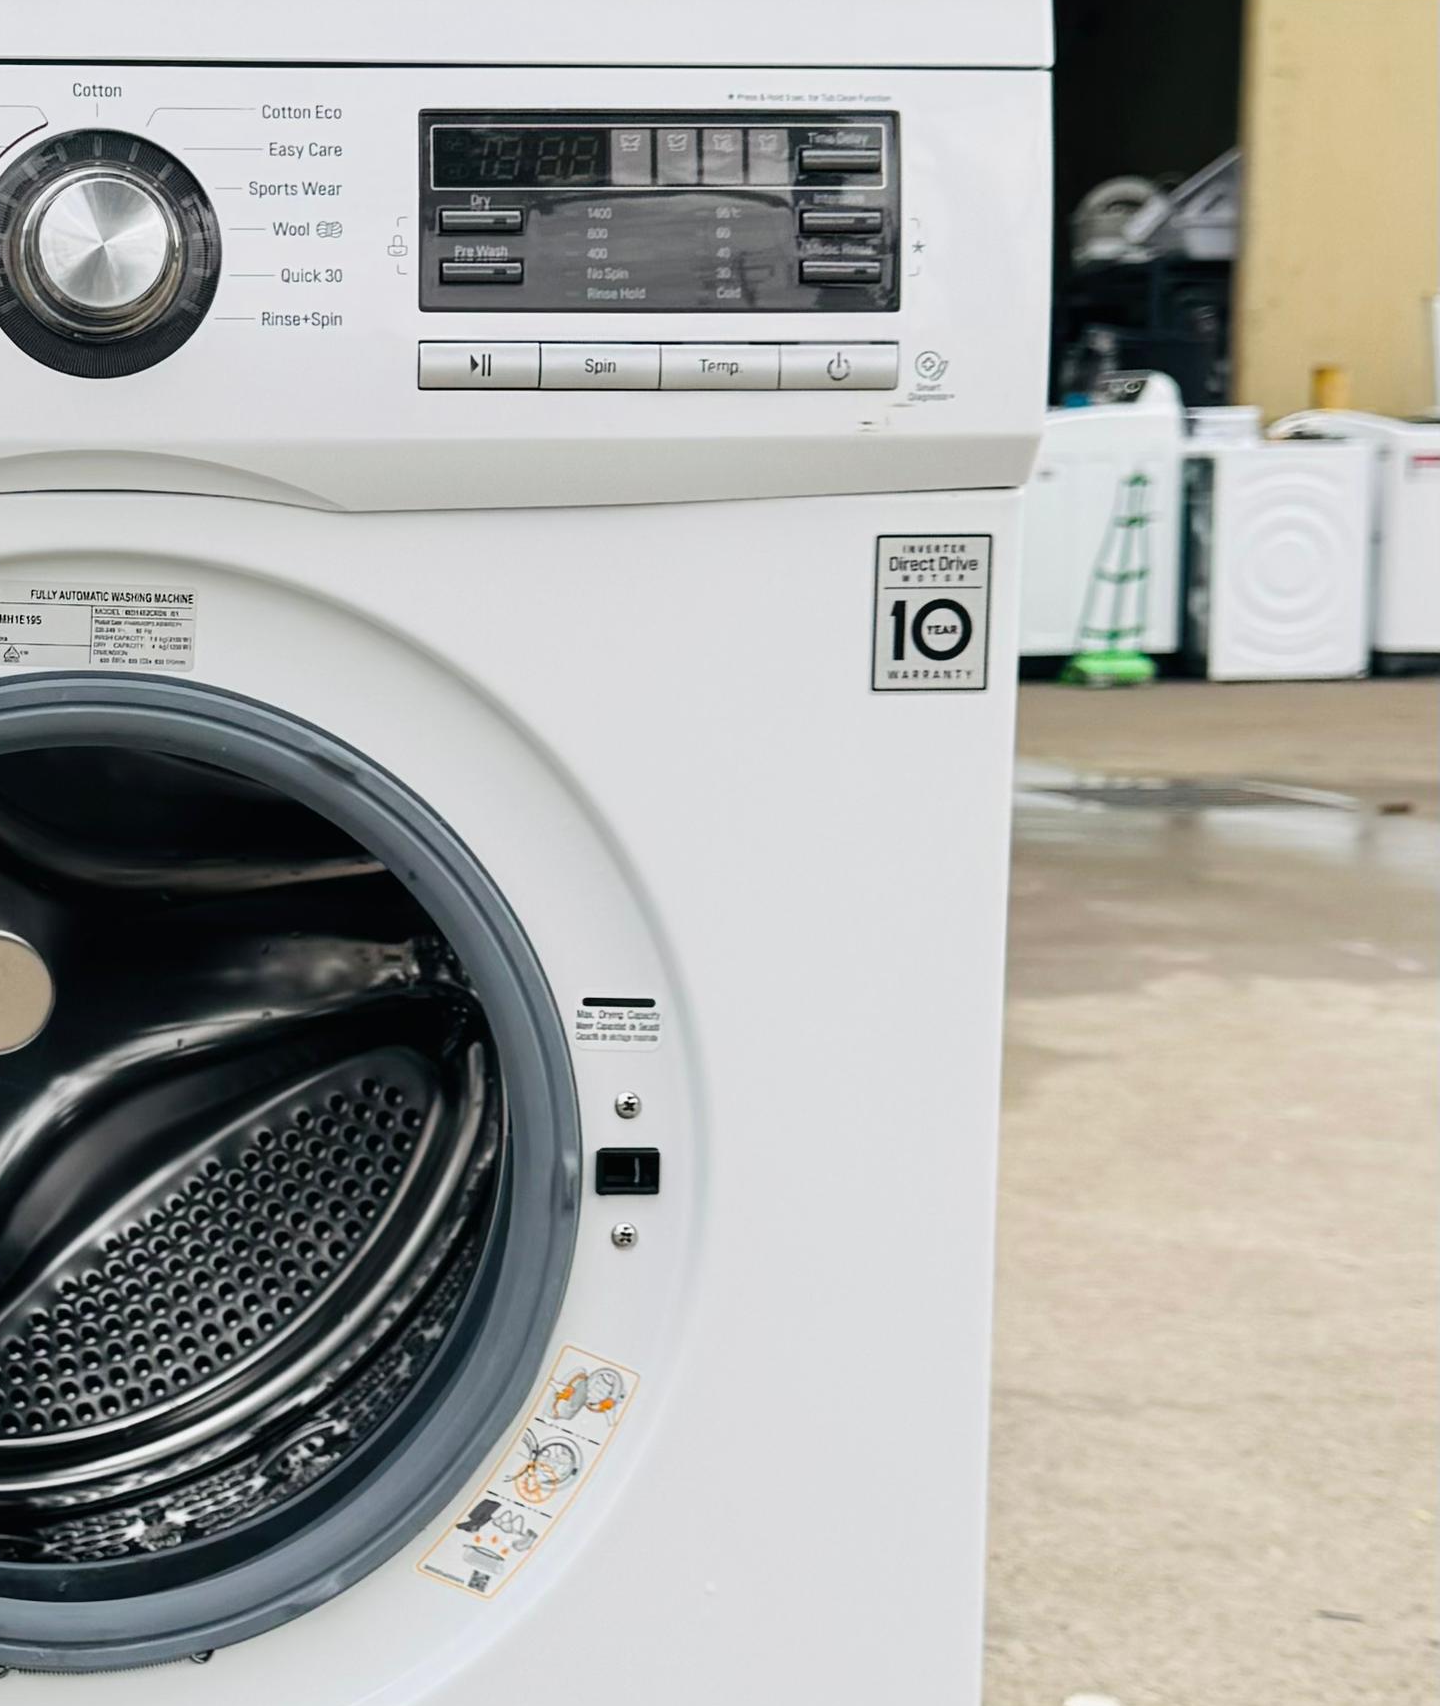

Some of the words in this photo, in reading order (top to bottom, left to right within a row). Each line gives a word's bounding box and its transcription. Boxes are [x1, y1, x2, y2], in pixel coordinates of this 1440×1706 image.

[73, 83, 122, 98] Cotton
[262, 105, 311, 120] Cotton
[315, 105, 342, 120] Eco
[269, 142, 304, 160] Easy
[309, 143, 343, 158] Care
[249, 181, 298, 198] Sports
[303, 182, 343, 196] Wear
[471, 195, 491, 208] Dry
[587, 208, 612, 219] 1400
[273, 222, 310, 237] Wool
[587, 228, 608, 239] 800
[454, 246, 474, 257] Pre
[476, 246, 508, 257] Wash
[587, 248, 608, 258] 400
[281, 269, 322, 283] Quick
[325, 269, 343, 283] 30
[587, 269, 602, 279] No
[604, 268, 628, 281] Spin
[587, 288, 618, 299] Rinse
[620, 288, 645, 299] Hold
[716, 286, 741, 299] Cold
[261, 312, 343, 330] Rinse+Spin
[584, 359, 617, 376] Spin
[700, 360, 743, 376] Temp.
[902, 544, 966, 553] INVERTER
[889, 556, 935, 571] Direct
[939, 556, 979, 571] Drive
[902, 574, 965, 582] MOTOR
[31, 590, 57, 600] FULLY
[59, 590, 110, 602] AUTOMATIC
[111, 592, 152, 603] WASHING
[154, 594, 194, 605] MACHINE
[890, 598, 972, 661] 10
[927, 625, 958, 635] YEAR
[888, 669, 973, 679] WARRANTY
